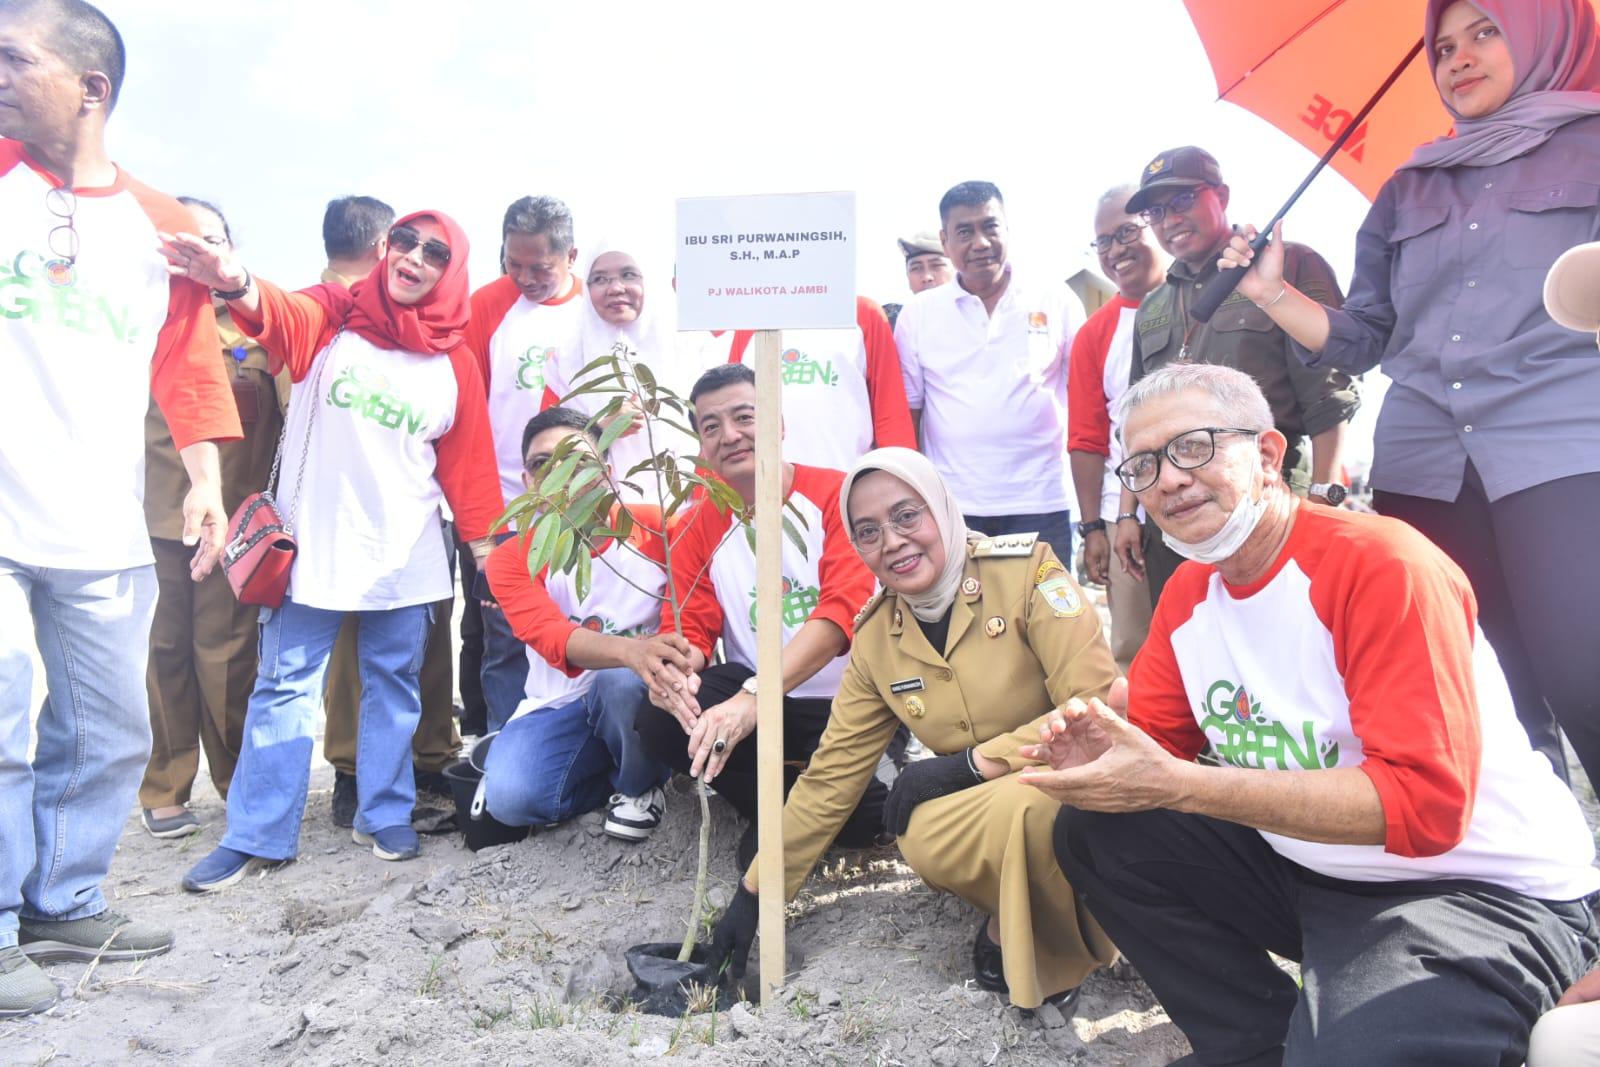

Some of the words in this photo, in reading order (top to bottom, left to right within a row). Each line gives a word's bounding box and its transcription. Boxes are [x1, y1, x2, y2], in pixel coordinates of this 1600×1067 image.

[685, 235, 708, 246] IBU
[711, 234, 733, 245] SRI
[737, 231, 847, 244] PURWANINGSIH,
[730, 251, 760, 261] S.H.,
[763, 249, 801, 260] M.A.P
[708, 287, 722, 297] PJ
[725, 286, 788, 296] WALIKOTA
[790, 285, 828, 295] JAMBI
[781, 360, 832, 386] REEN
[330, 378, 425, 436] GREEN
[1206, 679, 1252, 726] GO
[1200, 714, 1322, 770] GREEN
